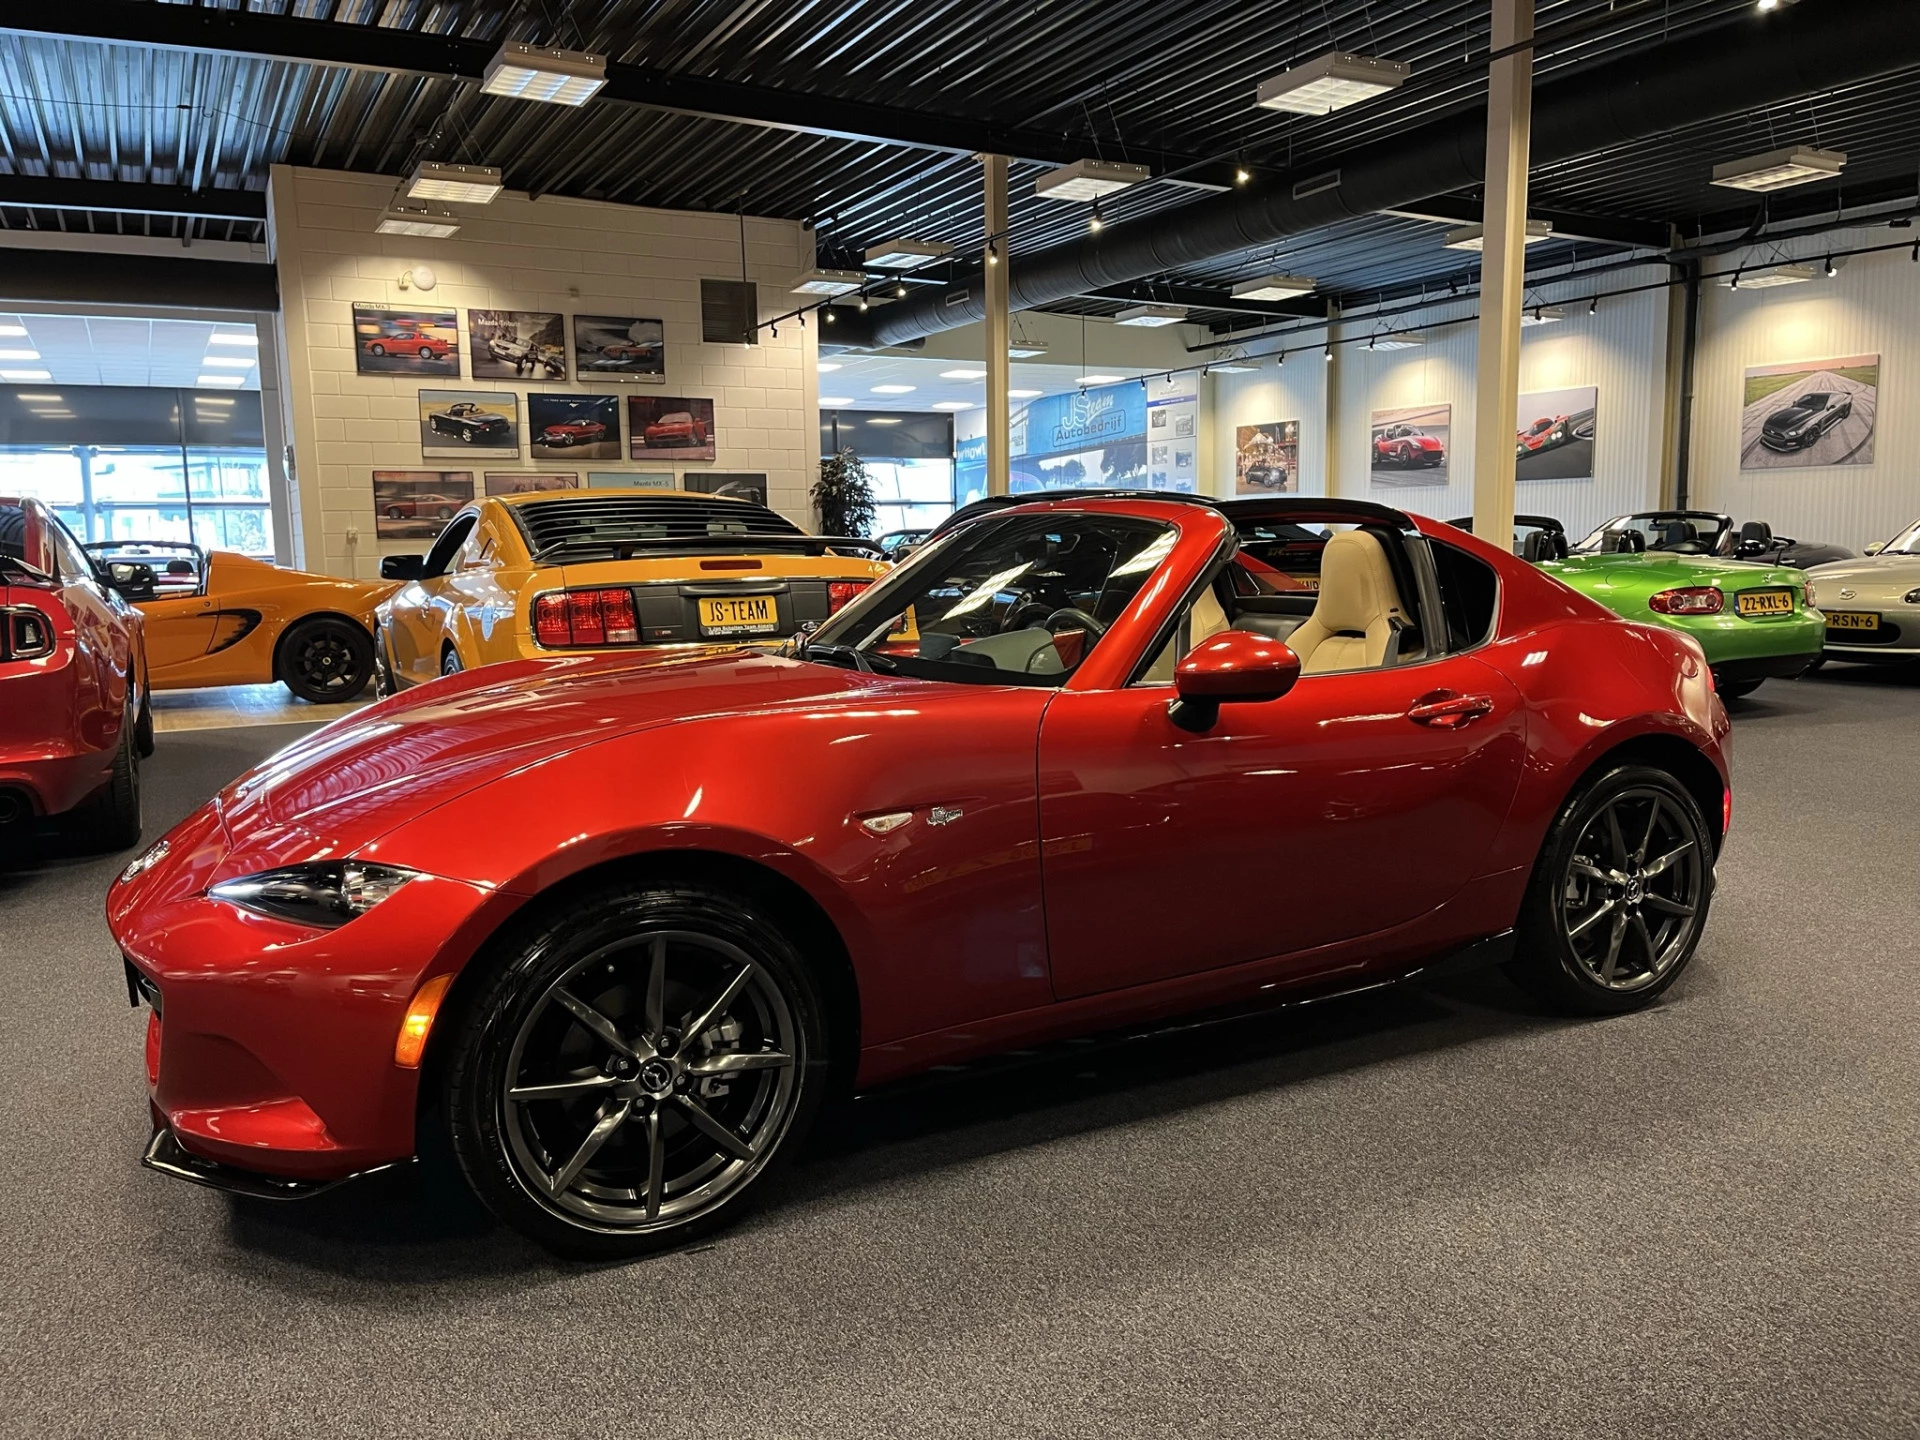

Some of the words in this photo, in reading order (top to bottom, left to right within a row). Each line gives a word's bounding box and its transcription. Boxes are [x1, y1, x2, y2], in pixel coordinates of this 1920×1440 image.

[1055, 415, 1122, 441] Autobedrijf
[710, 599, 768, 622] JS-TEAM
[1742, 594, 1789, 611] 22-RXL-6
